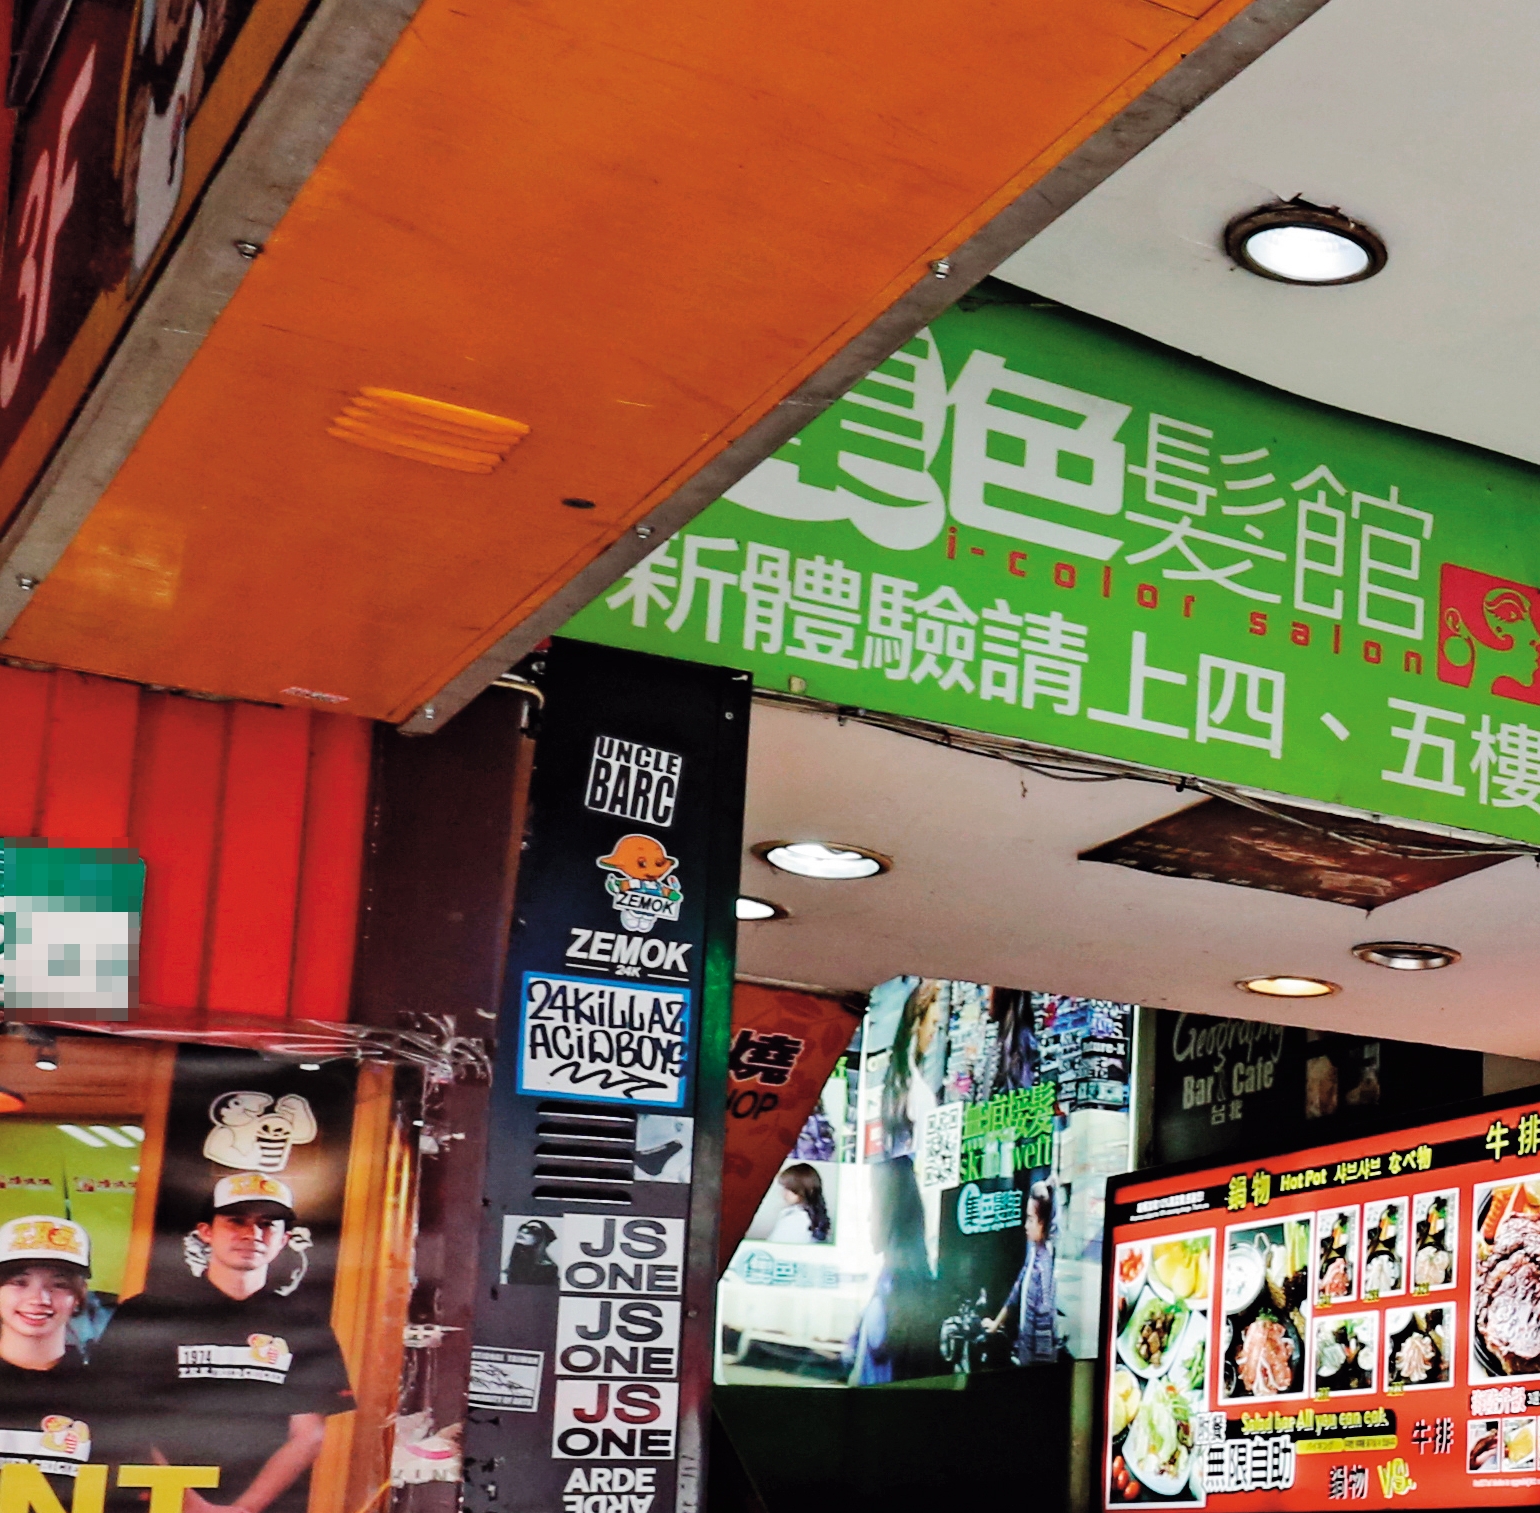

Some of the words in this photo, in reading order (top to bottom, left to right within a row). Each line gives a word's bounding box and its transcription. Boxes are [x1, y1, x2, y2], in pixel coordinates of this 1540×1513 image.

[944, 527, 1197, 618] i-color
[1247, 608, 1424, 676] salon
[598, 737, 681, 775] UNCLE
[587, 758, 676, 826] BARC
[615, 894, 676, 915] ZEMOK
[565, 927, 693, 973] ZEMOK
[1182, 1075, 1216, 1110] Bar
[1231, 1057, 1276, 1097] Cafe
[1226, 1170, 1272, 1212] 鍋物
[580, 1218, 667, 1260] JS
[565, 1261, 679, 1293] ONE
[575, 1300, 664, 1342] JS
[559, 1344, 674, 1375] ONE
[572, 1383, 661, 1424] JS
[556, 1427, 675, 1458] ONE
[563, 1467, 657, 1494] ARDE
[1203, 1436, 1299, 1493] 無限自助
